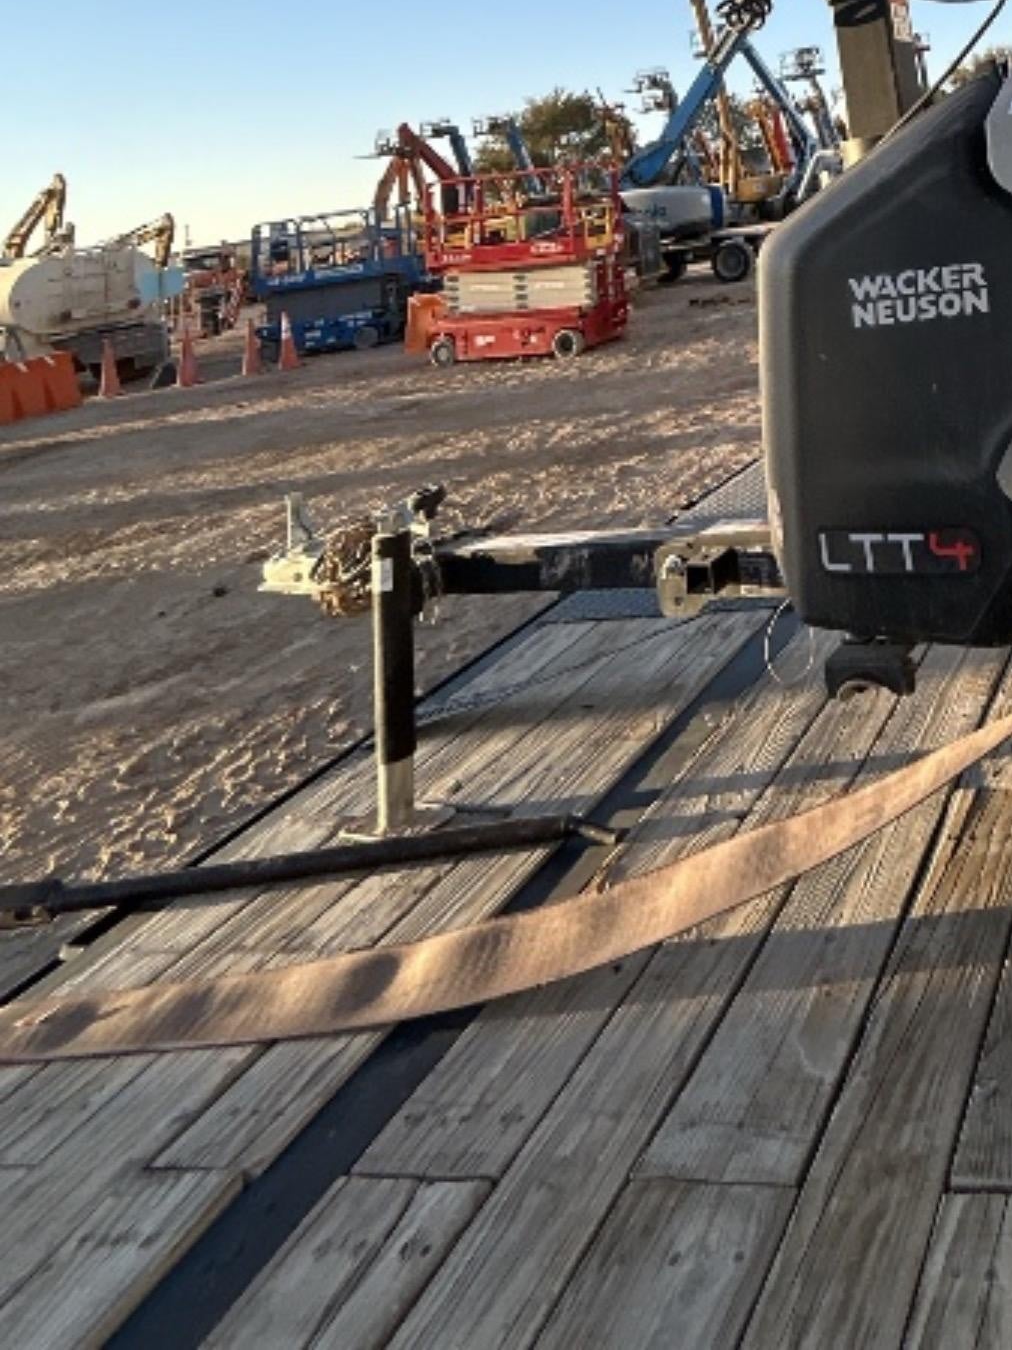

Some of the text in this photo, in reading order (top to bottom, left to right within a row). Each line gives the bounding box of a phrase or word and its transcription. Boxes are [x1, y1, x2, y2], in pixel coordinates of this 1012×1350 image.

[848, 262, 988, 301] WACKER
[851, 287, 989, 328] NEUSON
[818, 533, 975, 572] LTT4
